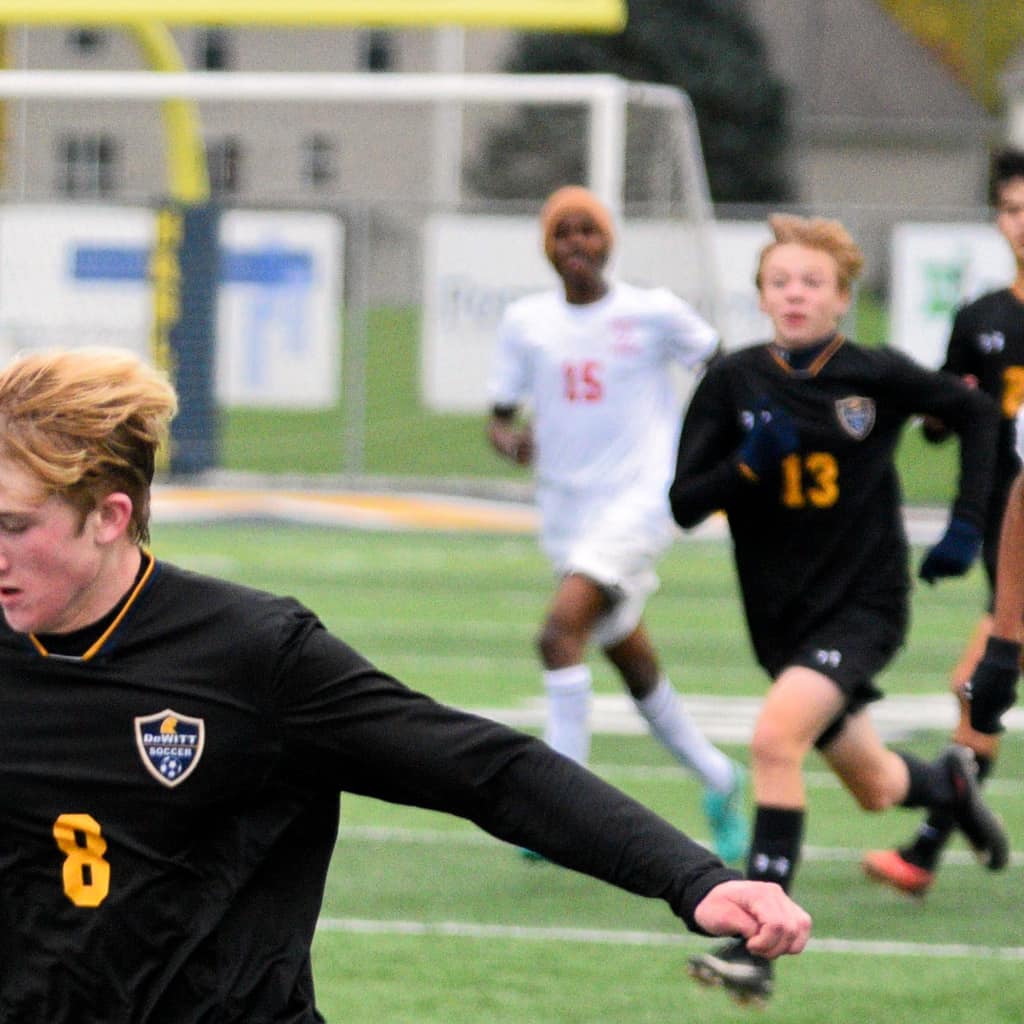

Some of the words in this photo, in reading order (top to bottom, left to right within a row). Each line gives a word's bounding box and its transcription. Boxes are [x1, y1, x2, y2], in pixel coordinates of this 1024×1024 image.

[561, 360, 604, 402] 15
[782, 453, 838, 507] 13
[143, 733, 197, 745] DeWITT
[149, 747, 192, 757] SOCCER
[53, 813, 111, 907] 8
